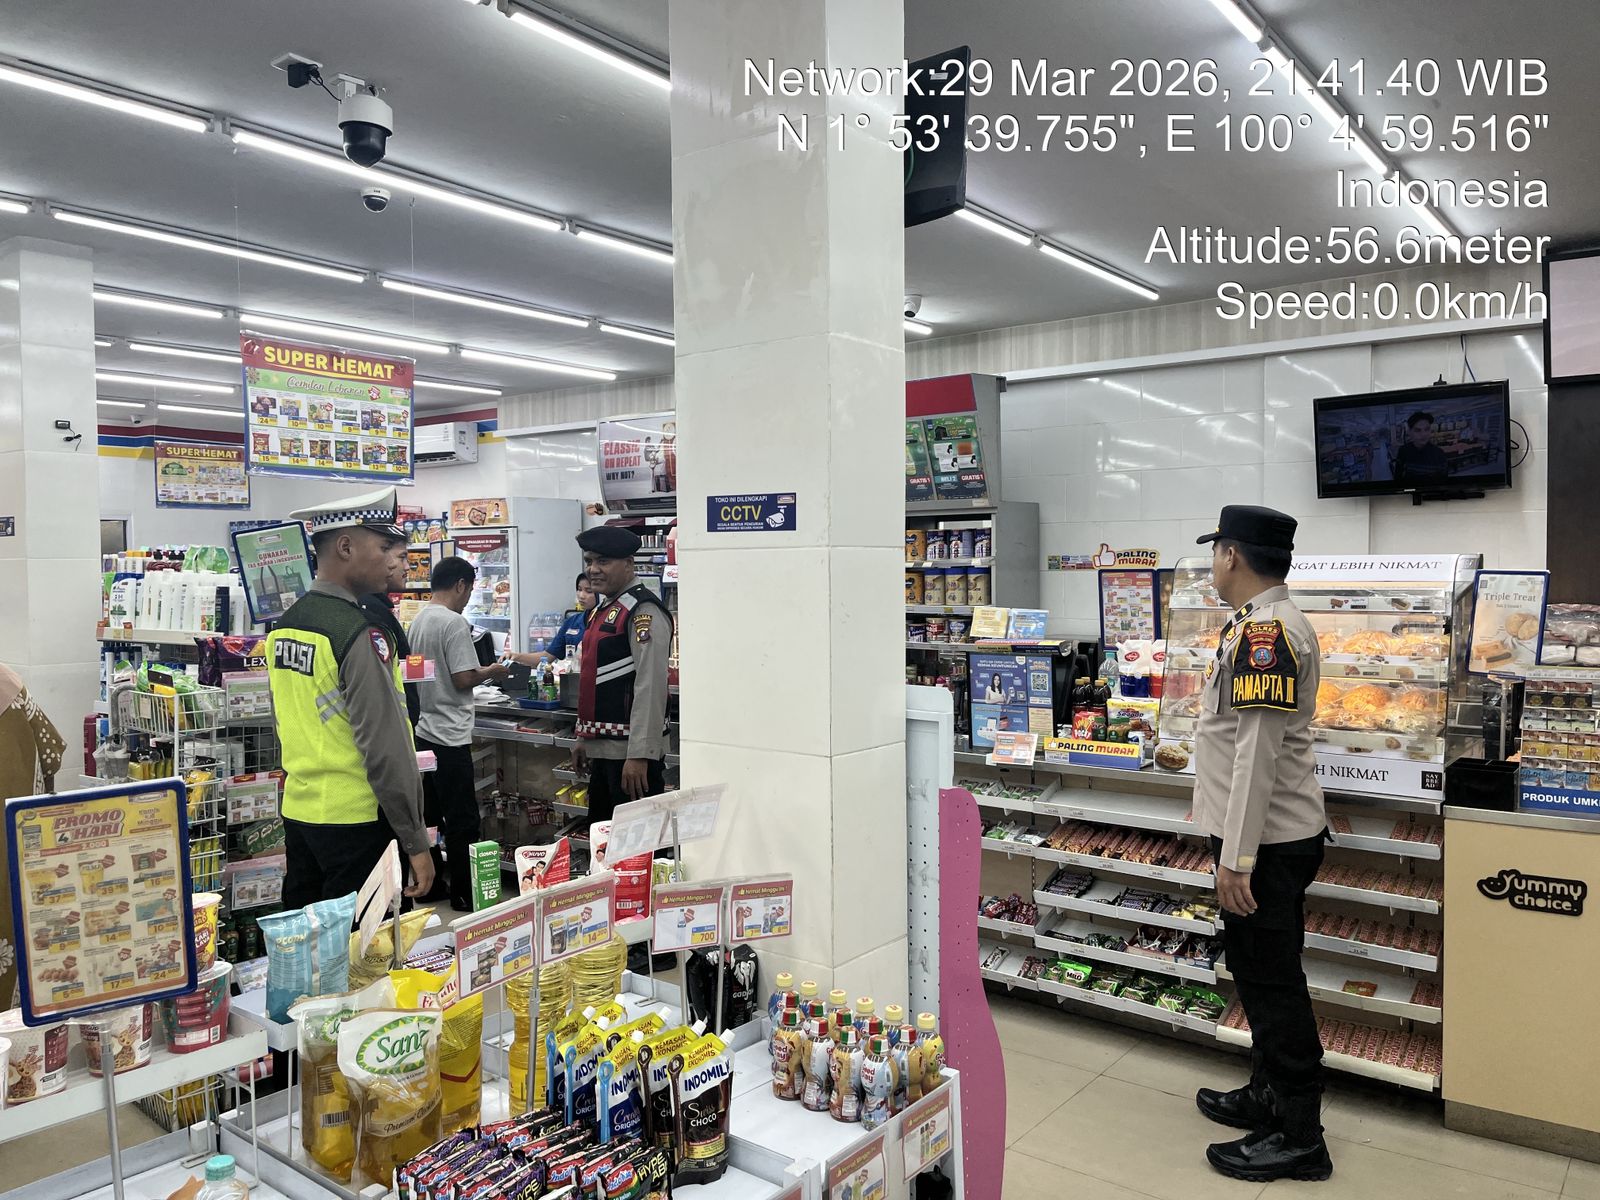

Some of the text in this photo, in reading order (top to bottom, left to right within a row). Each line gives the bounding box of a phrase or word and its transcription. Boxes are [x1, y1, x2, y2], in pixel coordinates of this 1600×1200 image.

[264, 346, 395, 380] SUPER HEMAT
[286, 375, 365, 397] Cemilan Lebaran
[166, 446, 239, 459] SUPER HEMAT
[604, 439, 641, 456] CLASSIC
[615, 456, 641, 468] REPEAT
[720, 505, 762, 521] CCTV
[258, 549, 288, 560] GUNAKAN
[1117, 551, 1157, 559] PALING
[1118, 558, 1157, 567] MURAH
[1289, 561, 1442, 570] NGAT LEBIH NIKMAT
[1484, 593, 1537, 602] Triple Treat
[1246, 625, 1279, 635] POLRES
[243, 657, 267, 667] LEX
[1232, 673, 1284, 703] PAMAPTA
[1057, 742, 1135, 756] PALING MURAH
[1330, 765, 1389, 781] NIKMAT
[1522, 792, 1570, 805] PRODUK
[54, 808, 125, 830] PROMO
[57, 822, 125, 844] 4 HARI
[761, 886, 779, 894] Minggu
[1482, 873, 1582, 901] Yummy
[482, 889, 498, 901] 18
[557, 896, 576, 907] Hemat
[576, 891, 597, 903] Minggu
[669, 895, 686, 903] Hemat
[685, 894, 706, 903] Minggu
[473, 925, 494, 938] Hemat
[494, 917, 517, 930] Minggu
[588, 933, 597, 942] 14
[699, 931, 715, 942] 700
[1065, 971, 1083, 981] MILO
[577, 1038, 598, 1055] KONOMIS
[655, 1033, 687, 1051] KEMASAN
[688, 1042, 713, 1060] KEMASAN
[688, 1049, 716, 1068] EKONOMIS
[690, 1113, 717, 1127] CHOCO
[637, 1151, 667, 1181] HYPE
